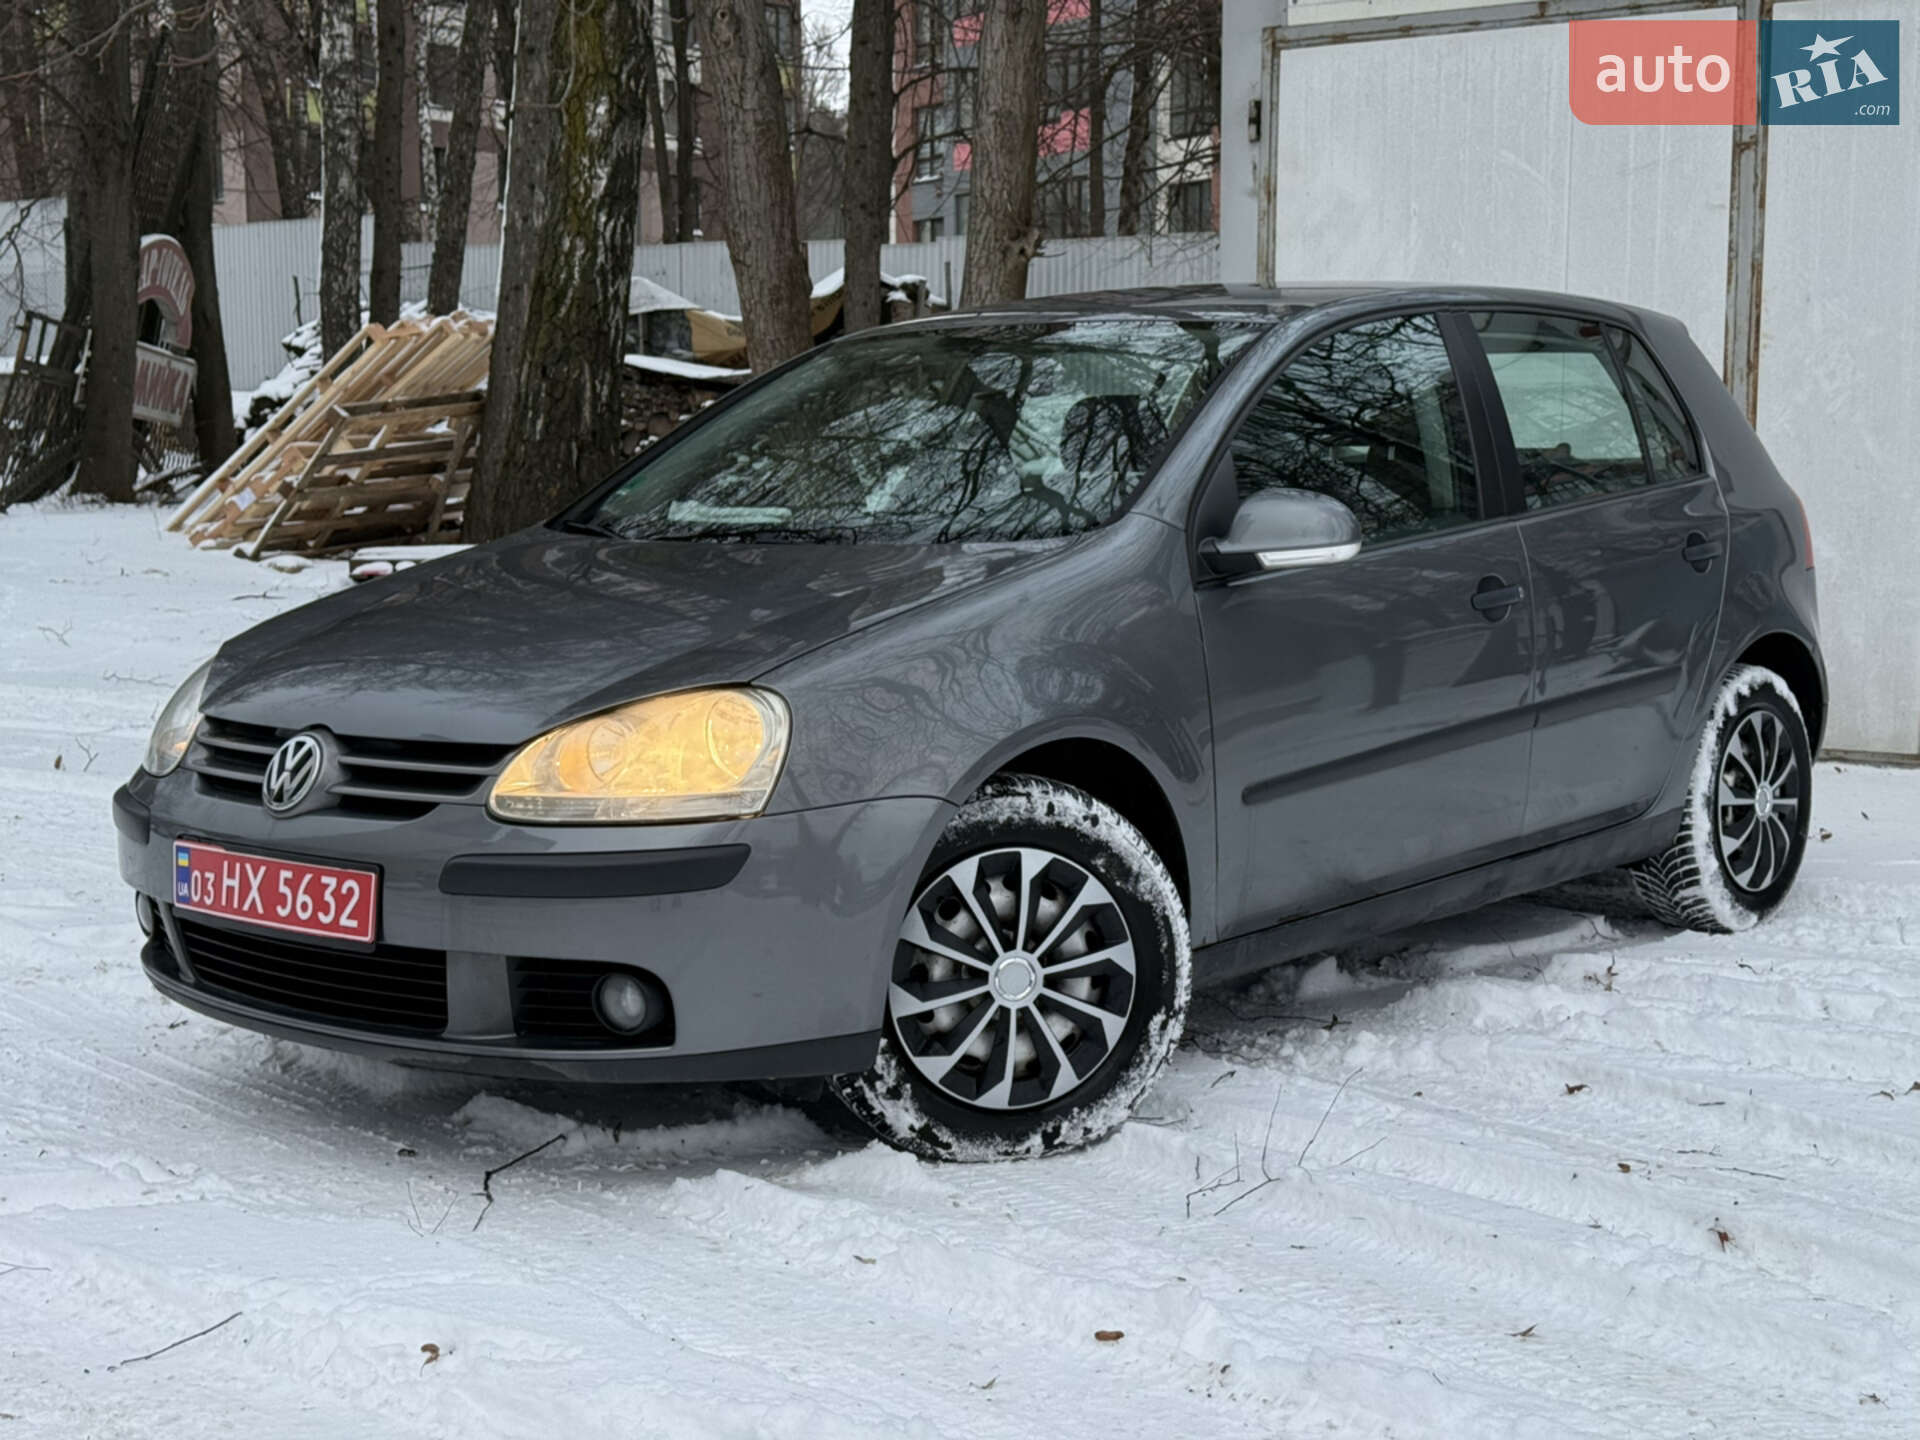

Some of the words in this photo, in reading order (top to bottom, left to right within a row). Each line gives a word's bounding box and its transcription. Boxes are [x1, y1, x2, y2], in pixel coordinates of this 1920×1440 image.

[177, 881, 190, 897] UA
[190, 869, 216, 906] 03
[221, 860, 267, 915] HX
[275, 869, 361, 929] 5632
